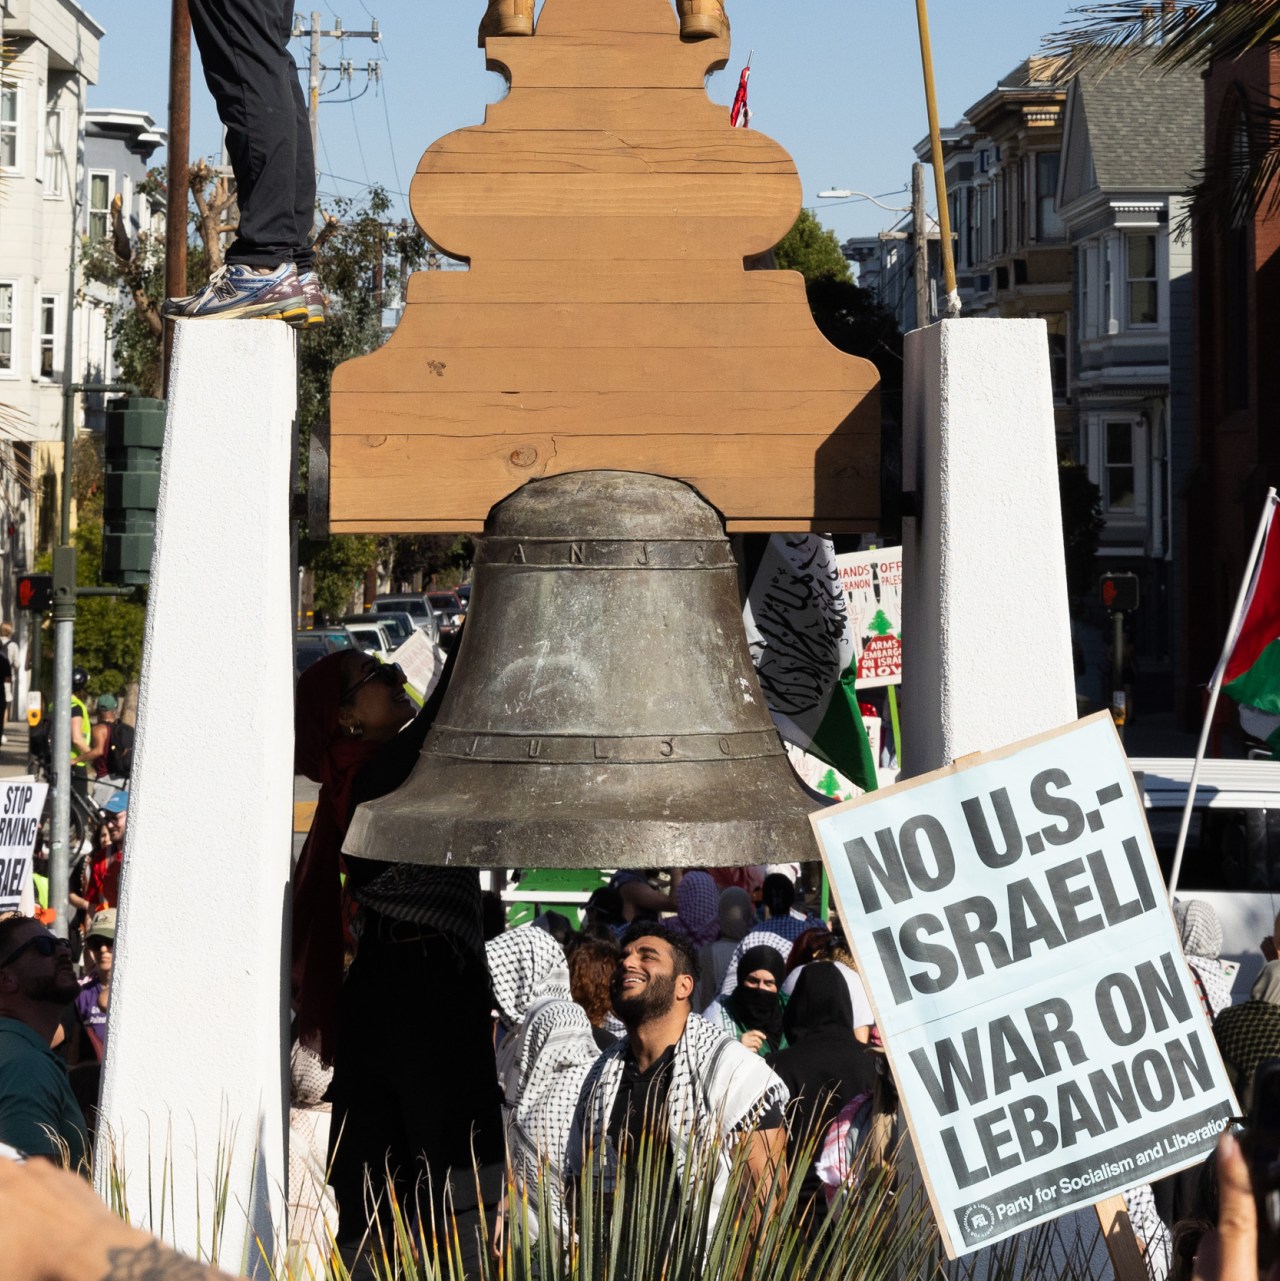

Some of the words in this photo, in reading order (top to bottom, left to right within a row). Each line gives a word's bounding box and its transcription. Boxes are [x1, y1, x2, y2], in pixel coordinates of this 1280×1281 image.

[862, 658, 874, 667] ON
[870, 639, 899, 650] ARMS
[3, 785, 33, 815] STOP
[842, 814, 956, 914] NO
[960, 767, 1124, 869] U.S.-
[872, 835, 1158, 1006] ISRAELI
[908, 997, 1090, 1117] WAR
[1095, 951, 1194, 1047] ON
[940, 1030, 1216, 1190] LEBANON
[995, 1192, 1034, 1221] Party
[1035, 1183, 1057, 1205] for
[1059, 1156, 1135, 1194] Socialism
[1136, 1143, 1163, 1167] and
[1163, 1116, 1231, 1154] Liberation
